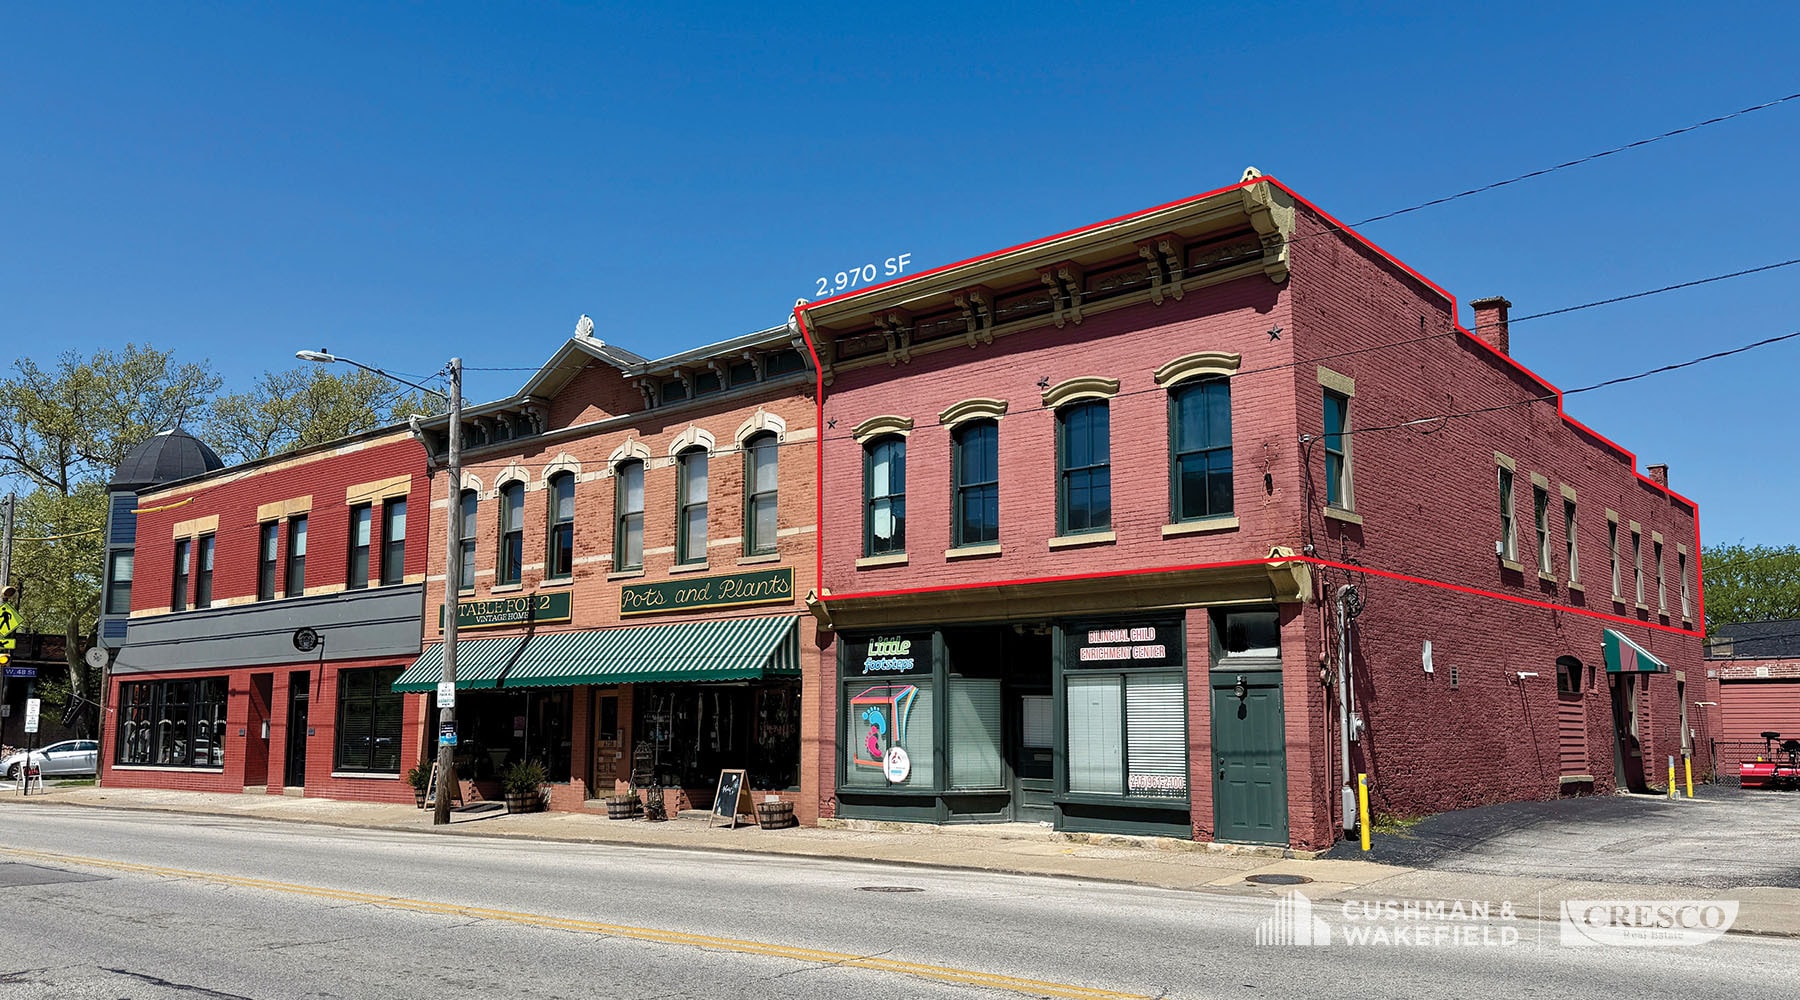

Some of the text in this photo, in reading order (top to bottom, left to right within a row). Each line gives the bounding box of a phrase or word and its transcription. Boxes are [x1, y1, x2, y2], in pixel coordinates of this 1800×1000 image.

[622, 575, 791, 608] Pots and Plants
[458, 595, 550, 617] TABLE FOR 2
[476, 612, 529, 623] VINTAGE HOME
[1088, 627, 1156, 644] BILINGUAL CHILD
[867, 635, 911, 656] Little
[1080, 645, 1166, 661] ENRICHMENT CENTER
[862, 656, 914, 675] footsteps
